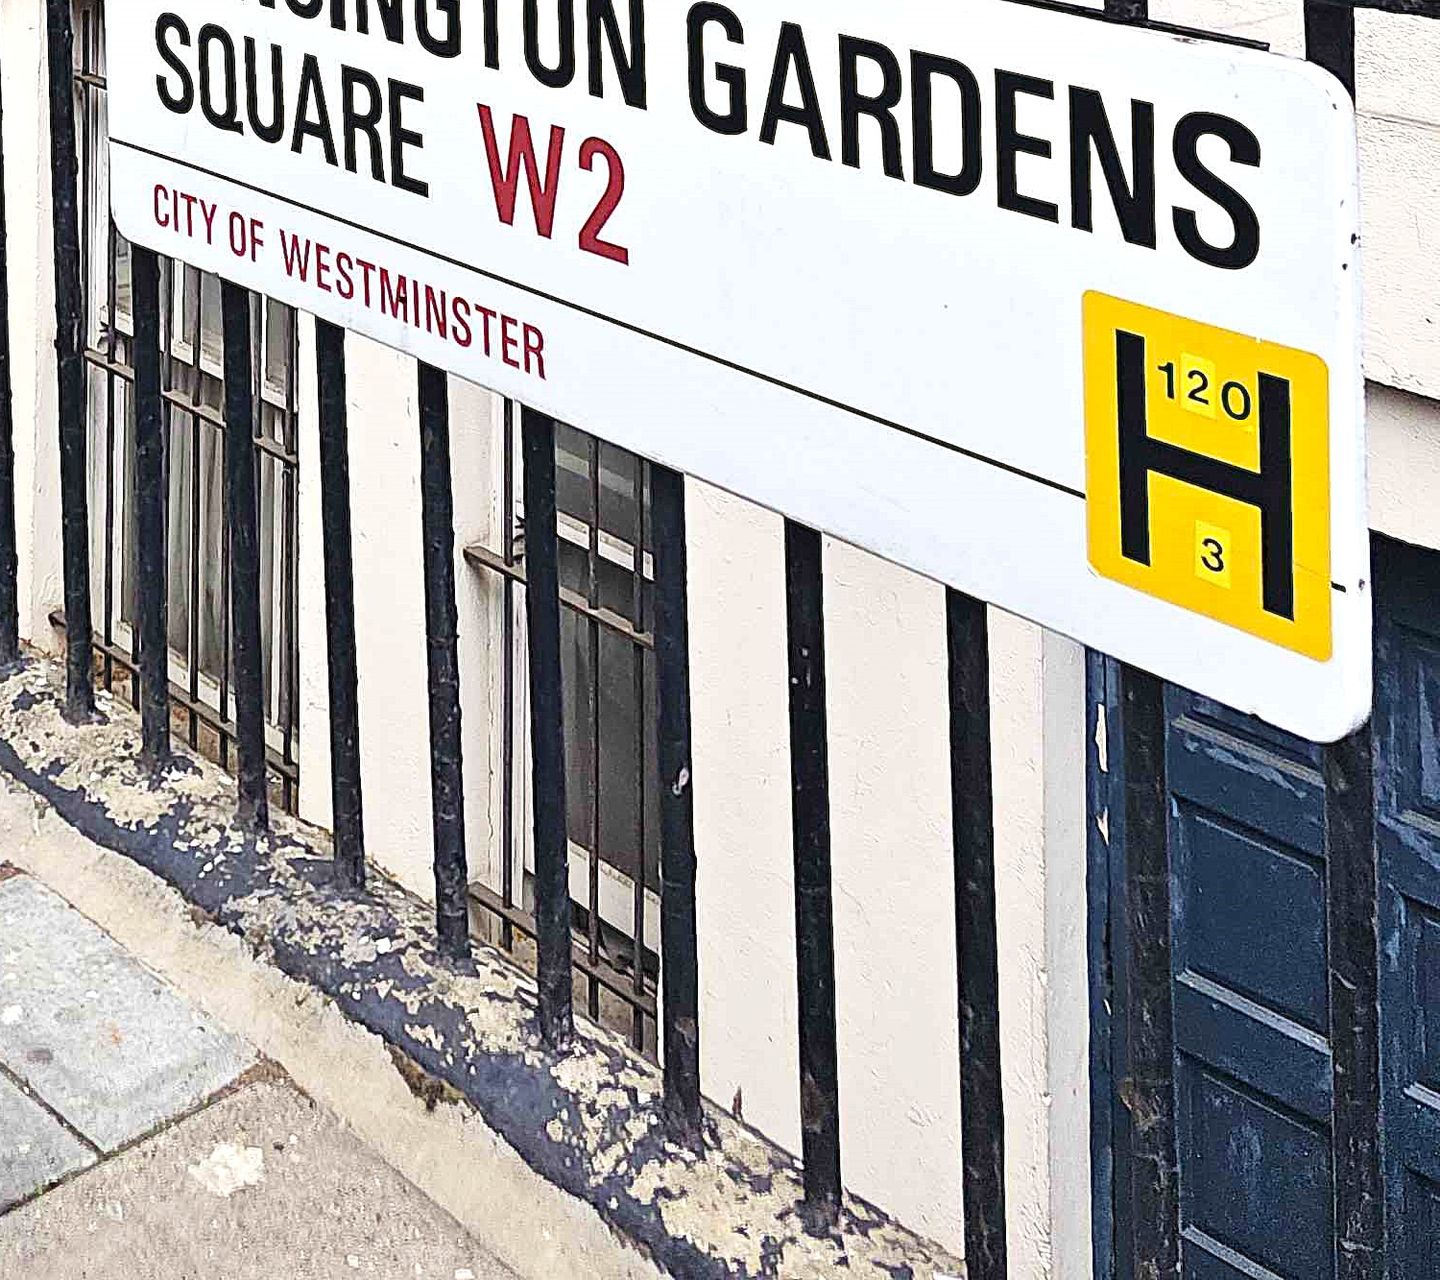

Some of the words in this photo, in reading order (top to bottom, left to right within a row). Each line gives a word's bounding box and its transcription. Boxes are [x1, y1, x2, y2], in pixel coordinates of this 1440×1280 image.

[154, 12, 430, 199] SQUARE
[476, 102, 629, 267] W2
[686, 0, 1261, 271] GARDENS
[152, 184, 218, 246] CITY
[229, 211, 264, 263] OF
[279, 228, 546, 381] WESTMINSTER
[1157, 361, 1252, 421] 120
[1115, 328, 1295, 622] H
[1200, 537, 1225, 573] 3
